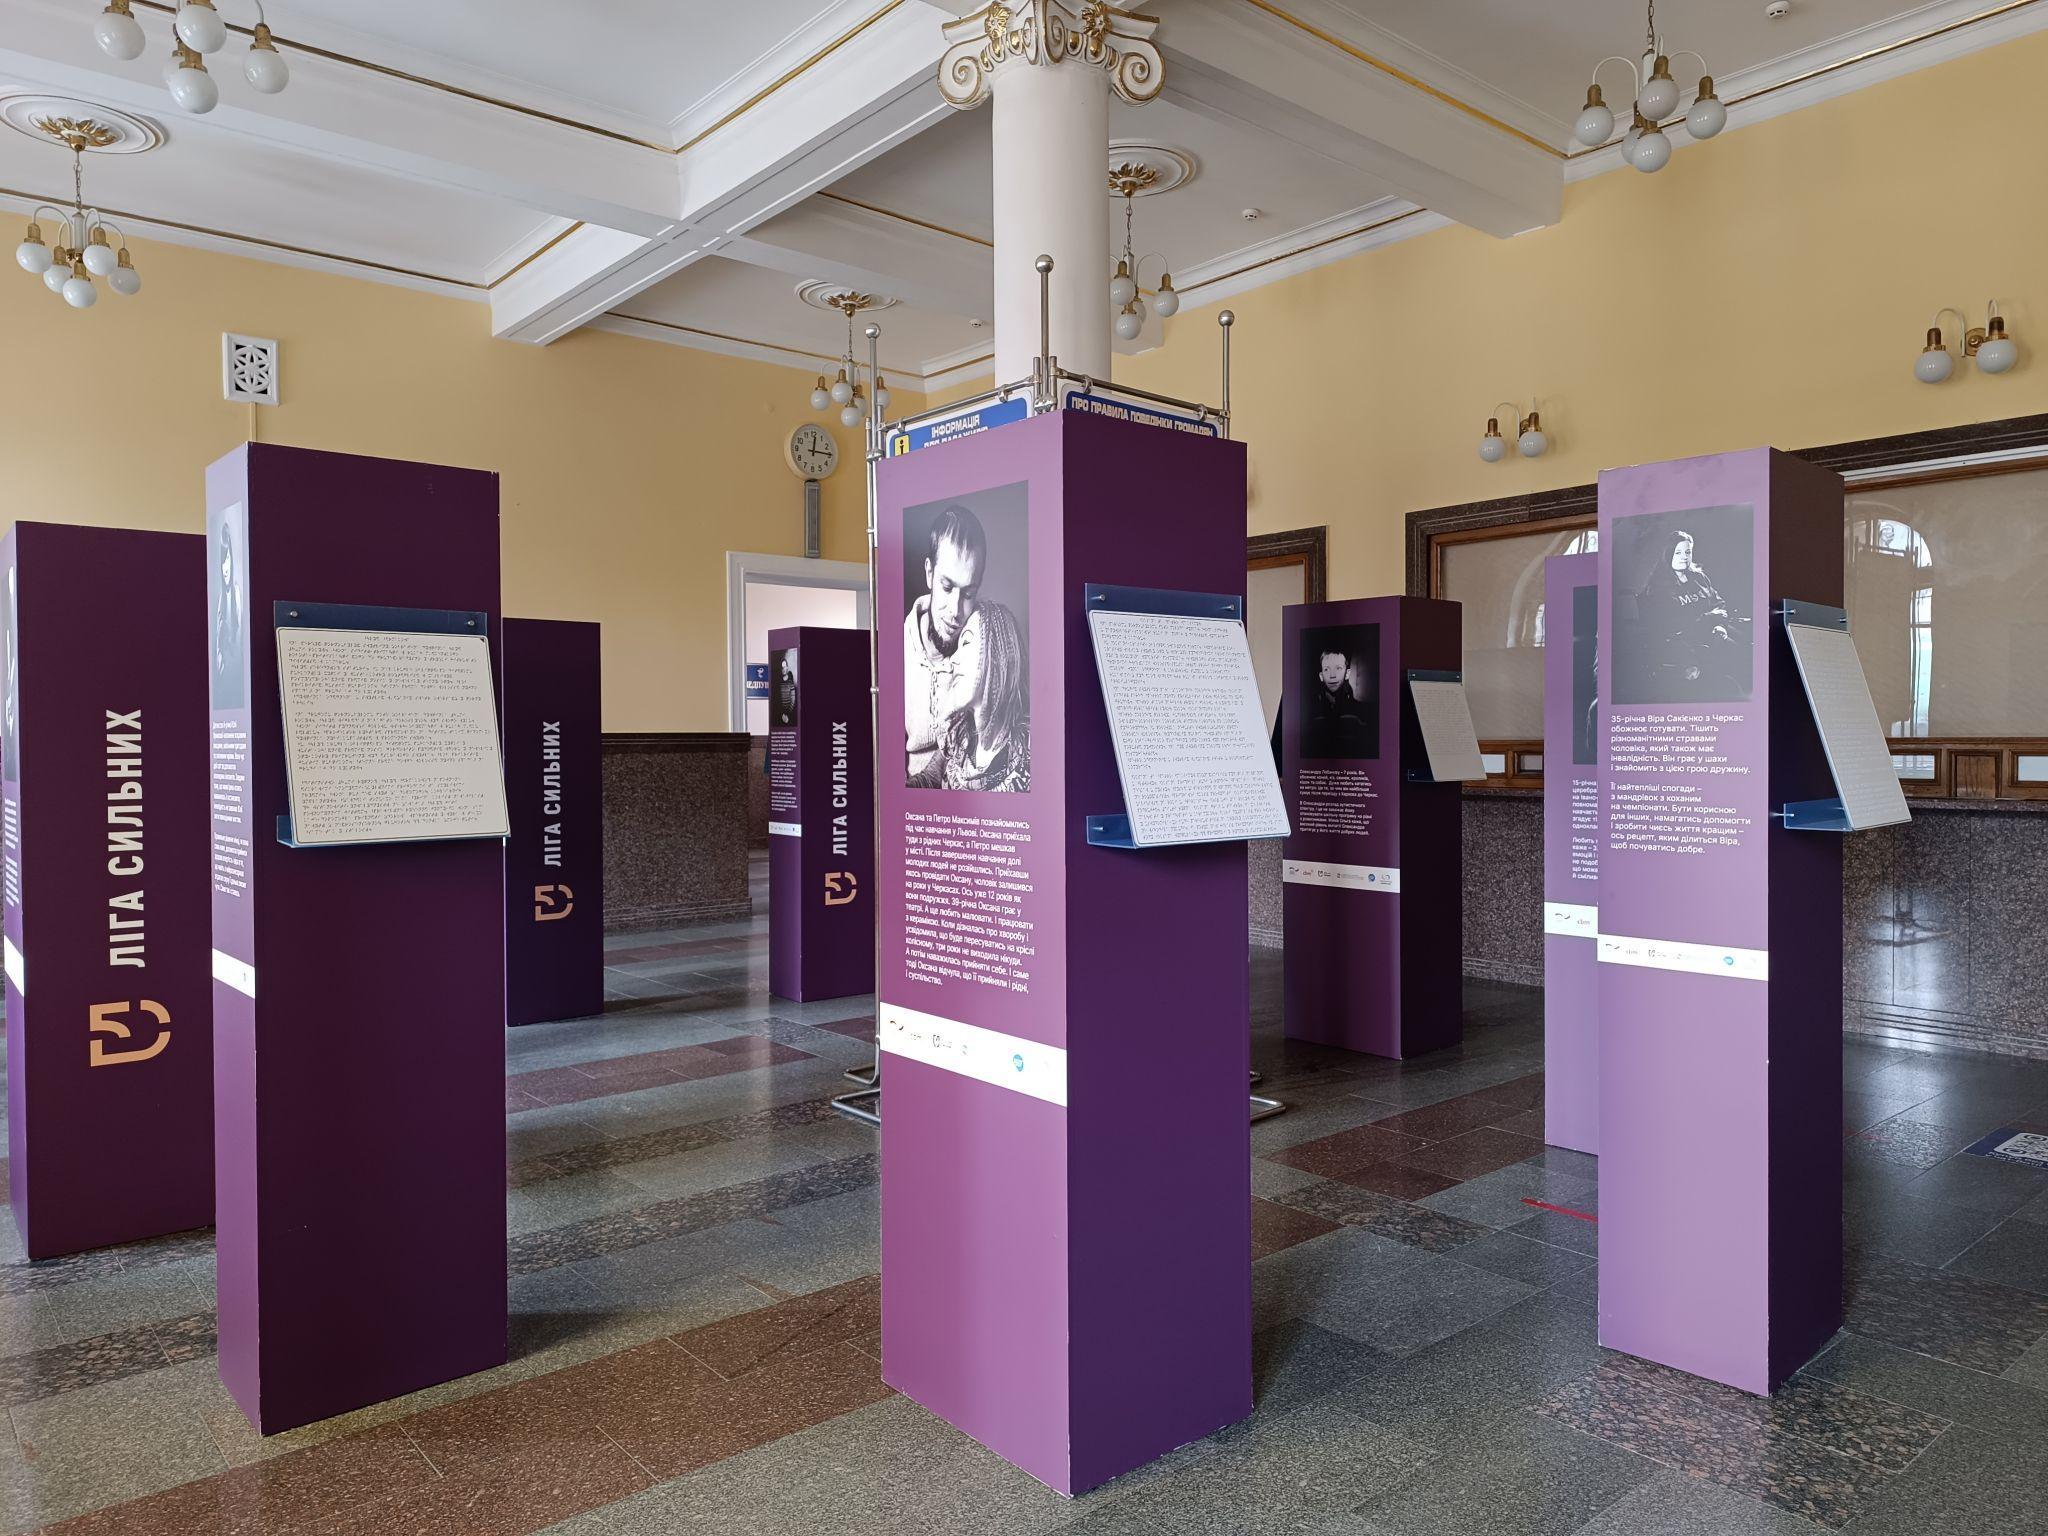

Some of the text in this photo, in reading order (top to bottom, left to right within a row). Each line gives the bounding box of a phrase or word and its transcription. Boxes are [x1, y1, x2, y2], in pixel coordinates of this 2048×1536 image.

[1072, 397, 1213, 437] ПРО ПРАВИЛА ПОВЕДІНКИ ГРОМАДЯН
[932, 414, 980, 438] ІНФОРМАЦІЯ
[1611, 716, 1645, 725] 35-річна
[1647, 716, 1664, 724] Віра
[1712, 715, 1743, 724] Черкас
[1610, 735, 1673, 743] різноманітними
[1610, 744, 1647, 752] чоловіка,
[1610, 753, 1660, 761] інвалідність.
[1677, 755, 1695, 763] грає
[1665, 763, 1684, 771] цією
[832, 721, 848, 856] ЛІГА СИЛЬНИХ
[543, 721, 562, 867] ЛІГА СИЛЬНИХ
[1617, 793, 1658, 801] мандрівок
[1672, 804, 1691, 813] Бути
[1627, 812, 1651, 821] інших,
[1615, 822, 1647, 830] зробити
[1702, 827, 1736, 835] кращим
[106, 709, 146, 968] ЛІГА СИЛЬНИХ
[1626, 833, 1655, 841] рецепт,
[1680, 835, 1716, 843] ділиться
[1719, 837, 1740, 846] Віра,
[1677, 846, 1705, 855] добре.
